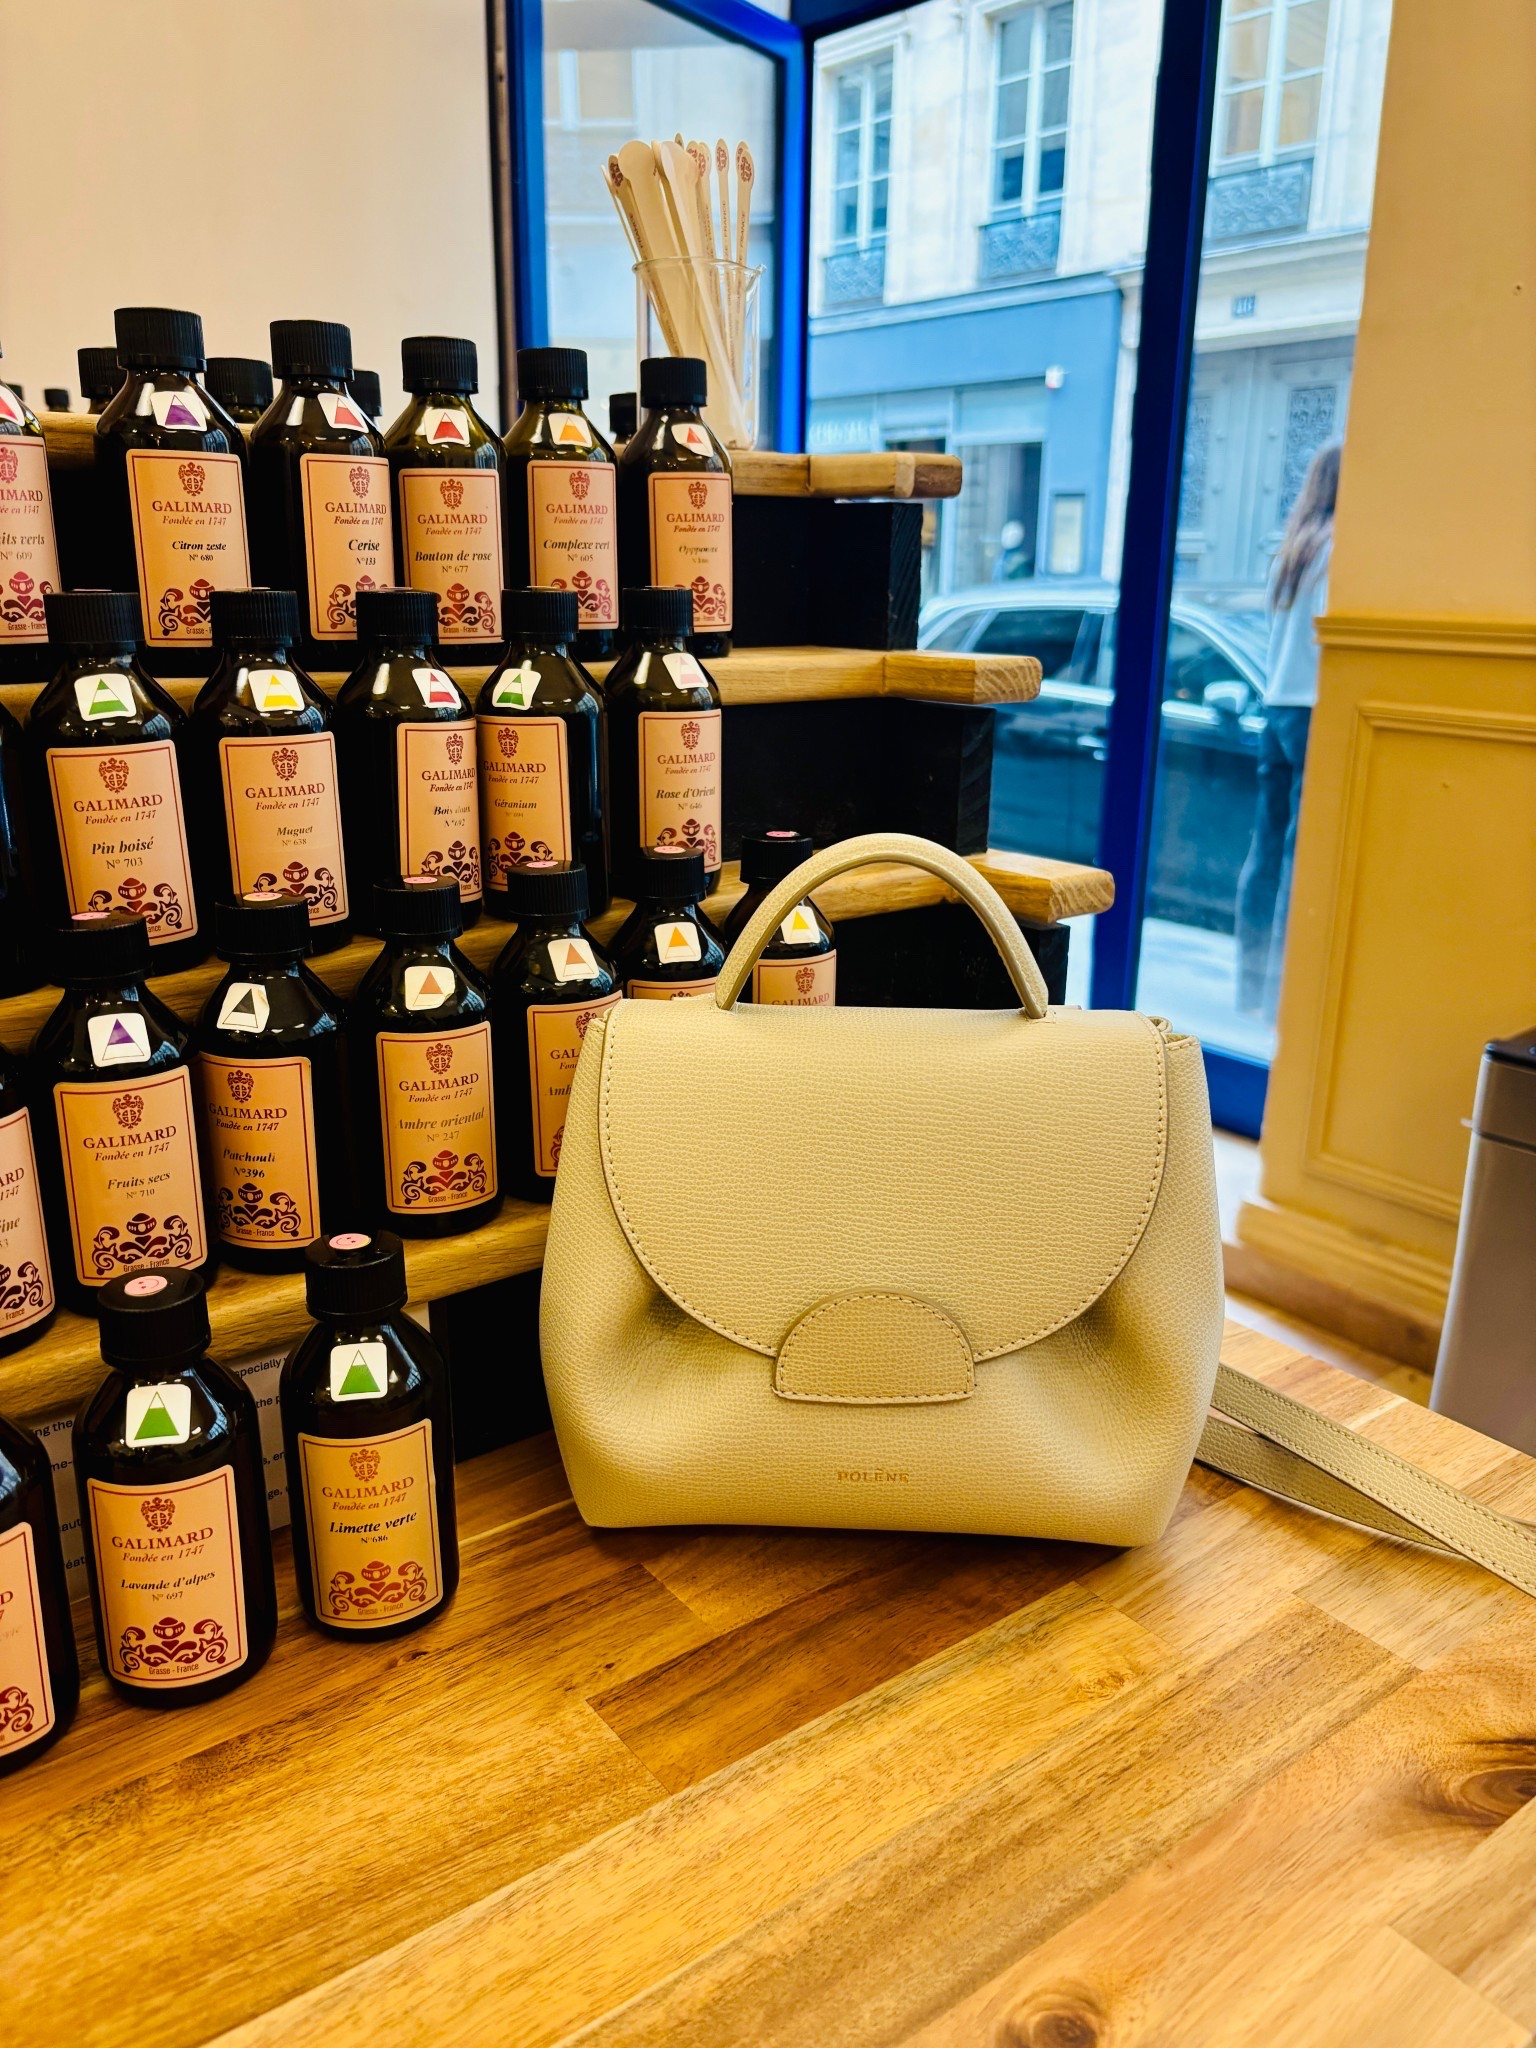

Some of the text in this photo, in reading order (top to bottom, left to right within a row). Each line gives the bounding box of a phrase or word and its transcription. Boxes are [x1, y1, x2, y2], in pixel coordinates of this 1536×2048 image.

[0, 489, 43, 502] IMARD
[152, 501, 232, 514] GALIMARD
[325, 502, 386, 515] GALIMARD
[546, 504, 608, 514] GALIMARD
[163, 515, 193, 525] Fondée
[208, 517, 226, 526] 1747
[334, 516, 360, 525] Fondée
[371, 517, 383, 525] 1747
[418, 514, 487, 524] GALIMARD
[666, 514, 724, 522] GALIMARD
[426, 527, 451, 535] Fondée
[465, 527, 482, 535] 1747
[674, 525, 697, 533] Fondée
[20, 533, 45, 545] verts
[172, 541, 226, 550] Citron zeste
[348, 539, 380, 552] Cerise
[544, 539, 593, 551] Complexe
[0, 552, 13, 560] N°
[416, 550, 492, 561] Bouton de rose
[567, 554, 578, 562] N°
[8, 622, 27, 631] Grasse
[186, 627, 204, 635] Grasse
[657, 752, 715, 765] GALIMARD
[483, 760, 546, 773] GALIMARD
[665, 766, 689, 775] Fondée
[421, 768, 475, 781] GALIMARD
[488, 774, 508, 784] Fondée
[520, 776, 539, 784] 1747
[245, 782, 325, 799] GALIMARD
[430, 783, 455, 792] Fondée
[656, 789, 680, 799] Rose
[73, 794, 163, 813] GALIMARD
[255, 800, 286, 811] Fondée
[301, 797, 320, 808] 1747
[494, 798, 537, 809] Géranium
[85, 809, 156, 825] Fondée en 1747
[433, 806, 453, 815] Bois
[277, 825, 313, 838] Muguet
[92, 836, 154, 855] Pin boisé
[106, 857, 143, 870] N° 703
[147, 924, 161, 933] ance
[559, 1062, 577, 1070] Fon
[399, 1073, 479, 1091] GALIMARD
[408, 1087, 473, 1103] Fondée en 1747
[545, 1087, 571, 1096] Amb
[209, 1103, 287, 1119] GALIMARD
[395, 1107, 484, 1130] Ambre oriental
[216, 1119, 241, 1131] Fondée
[256, 1122, 279, 1132] 1747
[83, 1125, 177, 1150] GALIMARD
[426, 1131, 460, 1143] N° 247
[95, 1142, 170, 1162] Fondée en 1747
[223, 1148, 276, 1163] Patchouli
[107, 1172, 170, 1190] Fruits secs
[140, 1188, 155, 1197] 710
[428, 1190, 468, 1203] Grasse France
[236, 1225, 275, 1237] Grasse France
[123, 1258, 170, 1273] Grasse France
[5, 1307, 25, 1321] France
[52, 1419, 73, 1432] the
[322, 1476, 414, 1499] GALIMARD
[332, 1492, 407, 1511] Fondée en 1747
[330, 1511, 417, 1534] Limette verte
[111, 1527, 214, 1550] GALIMARD
[123, 1544, 205, 1563] Fondée en 1747
[121, 1579, 169, 1590] Lavande
[166, 1591, 183, 1600] 697
[384, 1602, 404, 1613] France
[149, 1663, 199, 1675] Grasse France
